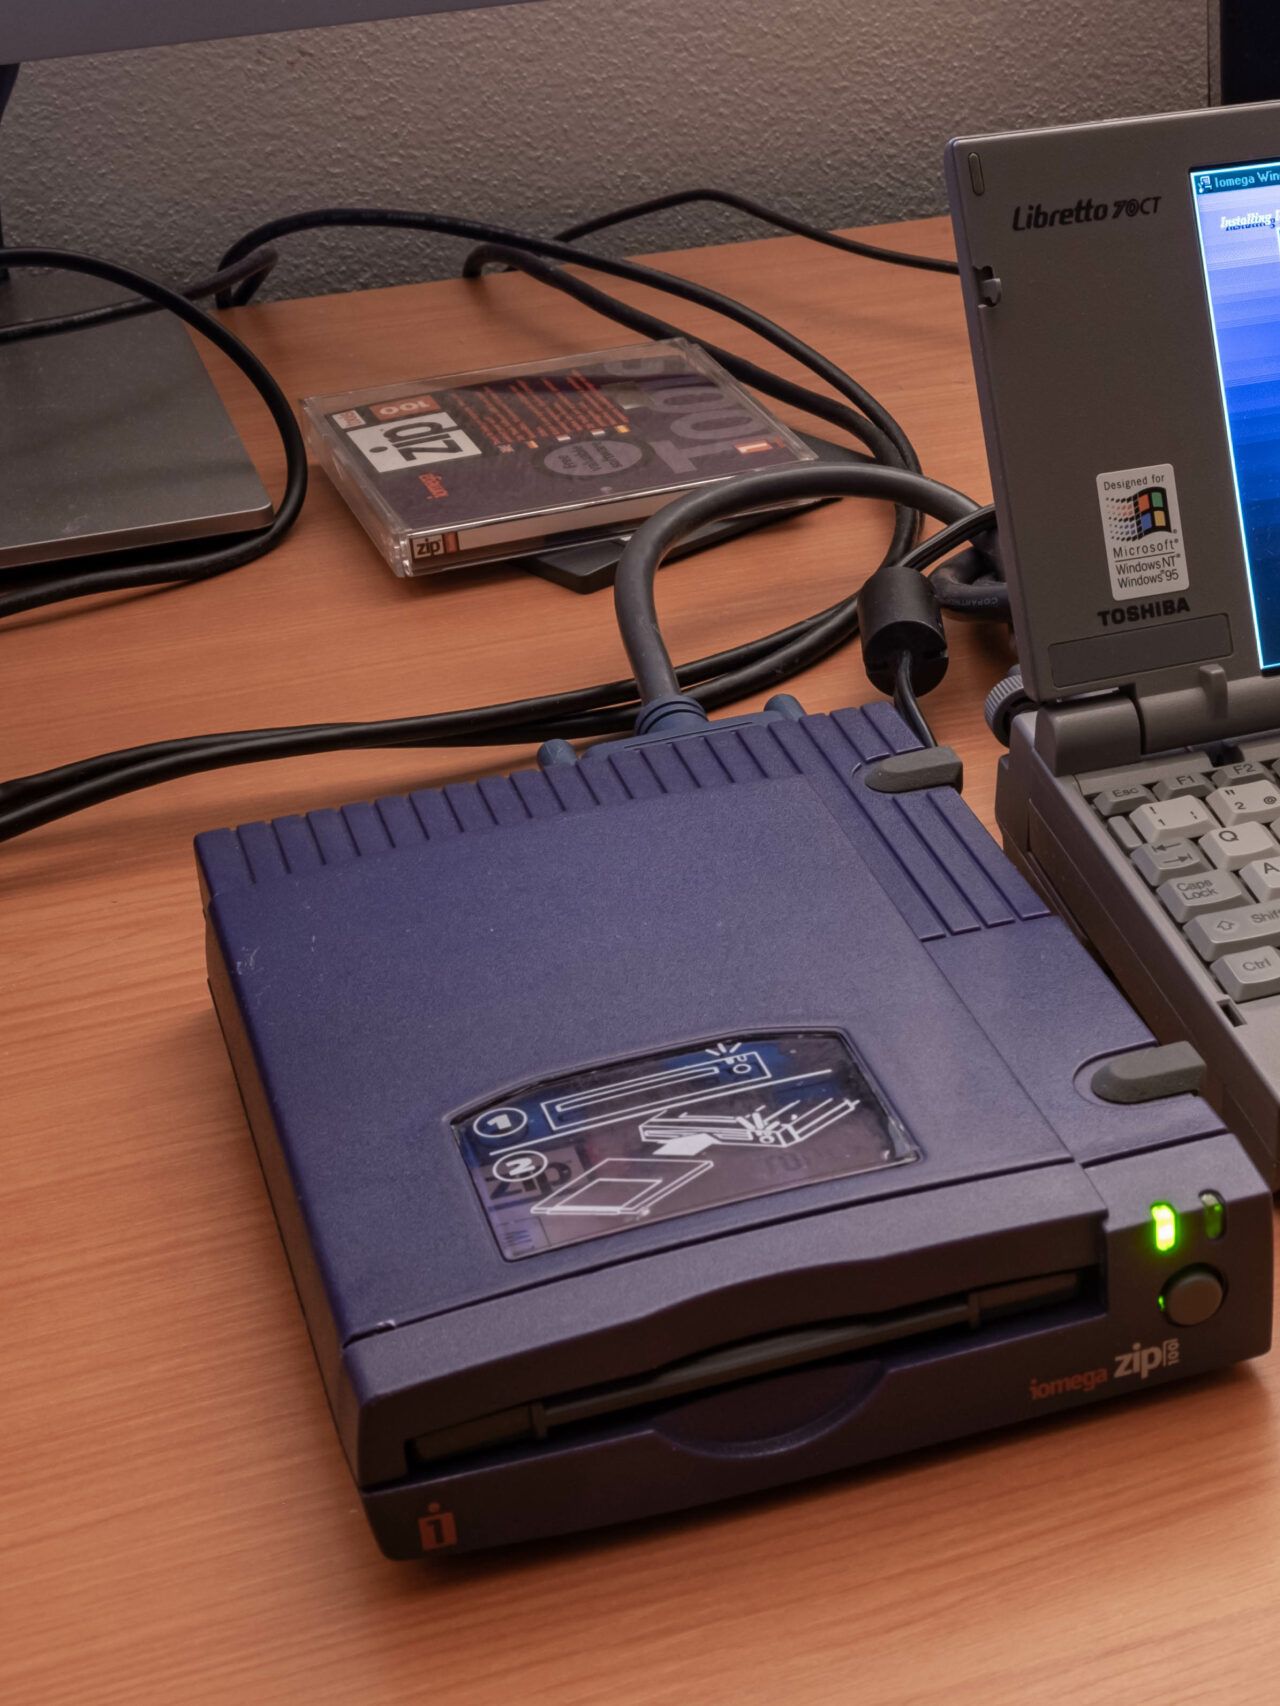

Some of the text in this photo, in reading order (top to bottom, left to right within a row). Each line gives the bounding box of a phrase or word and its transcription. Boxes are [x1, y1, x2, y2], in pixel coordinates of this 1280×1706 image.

[1214, 174, 1255, 188] Iomega
[1012, 198, 1108, 231] Libretto
[1220, 212, 1273, 230] Installing
[379, 400, 430, 415] 100
[369, 421, 464, 462] zip
[1103, 474, 1165, 491] Designed for
[416, 537, 441, 557] zip
[1115, 558, 1161, 575] Windows
[1166, 569, 1179, 581] 95
[1098, 597, 1190, 627] TOSHIBA
[1233, 763, 1254, 775] F2
[1176, 775, 1195, 786] F1
[1112, 786, 1139, 798] Esc
[1218, 830, 1240, 843] Q
[1263, 862, 1280, 876] A
[1176, 879, 1214, 893] Caps
[1182, 887, 1220, 902] Lock
[1242, 957, 1273, 972] Ctrl
[487, 1114, 512, 1131] 1
[505, 1157, 536, 1177] 2
[1166, 1340, 1180, 1367] 100
[1029, 1341, 1164, 1399] iomega zip
